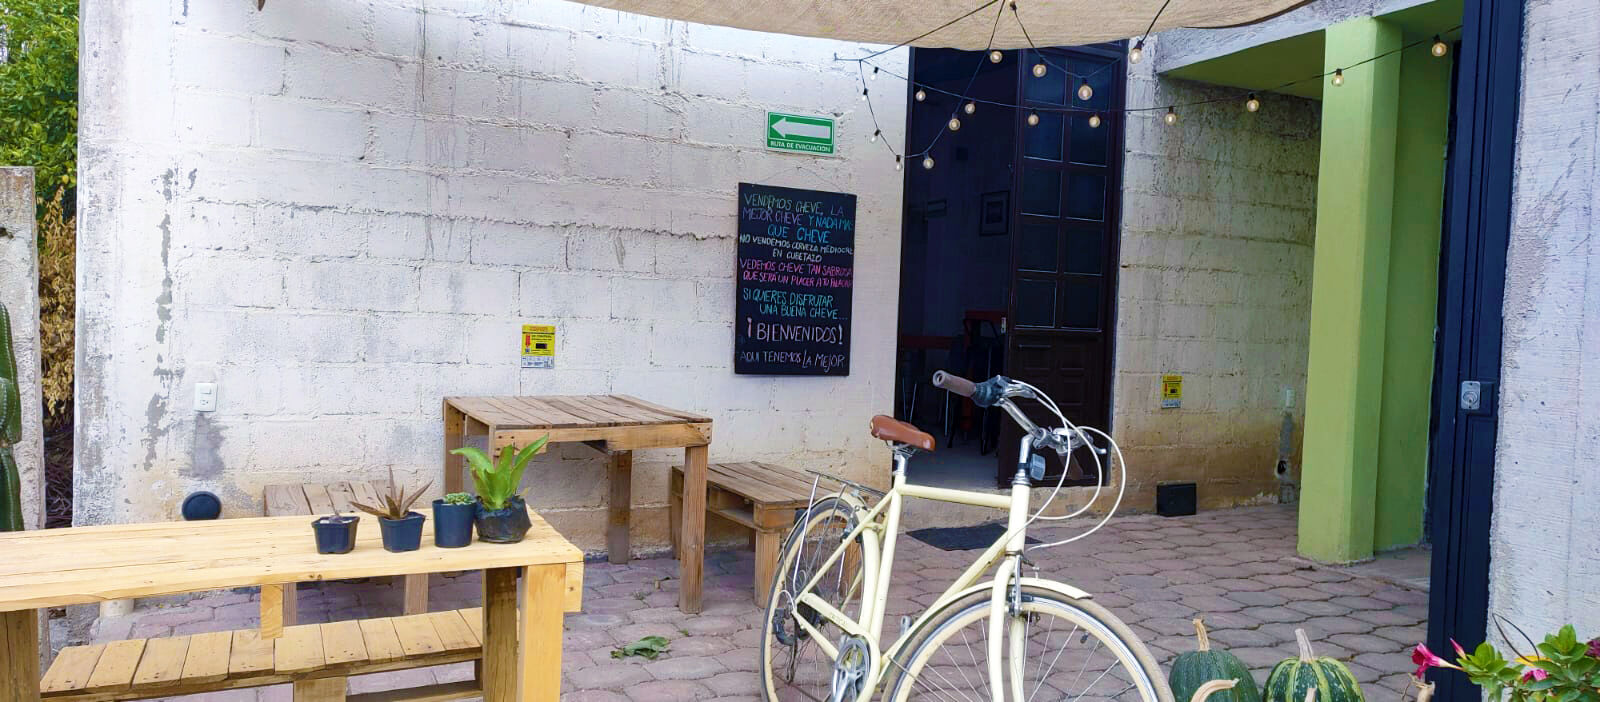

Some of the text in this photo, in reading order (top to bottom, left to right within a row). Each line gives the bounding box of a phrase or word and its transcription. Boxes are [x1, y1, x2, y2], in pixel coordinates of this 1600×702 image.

[744, 193, 792, 210] VENDEMOS
[830, 204, 845, 217] LA
[742, 207, 773, 222] MEJOR
[775, 210, 804, 226] CHEVE
[808, 214, 816, 227] Y
[740, 233, 751, 244] NO
[752, 237, 790, 249] VENDEMOS
[791, 241, 819, 253] CERVEZA
[767, 224, 831, 243] QUE CHEVE
[772, 248, 783, 258] EN
[743, 270, 759, 281] QUE
[777, 273, 789, 286] UN
[778, 262, 804, 274] CHEVE
[807, 264, 821, 276] TAN
[743, 288, 833, 307] SI QUIERES DISFRUTAR
[760, 303, 778, 316] UNA
[780, 305, 808, 318] BUENA
[763, 350, 800, 364] TENEMOS
[801, 349, 813, 368] LA
[814, 353, 846, 373] MEJOR
